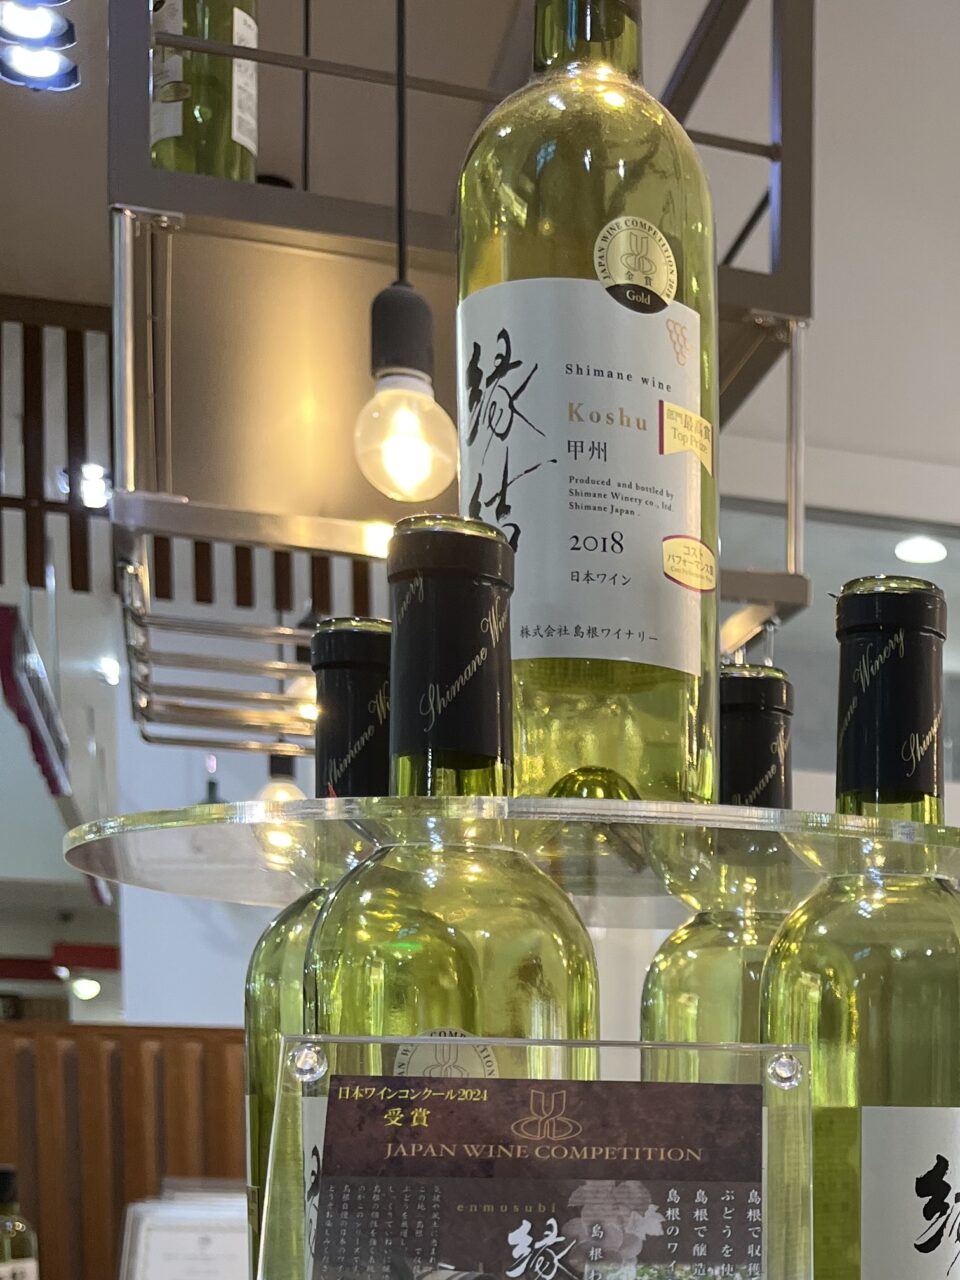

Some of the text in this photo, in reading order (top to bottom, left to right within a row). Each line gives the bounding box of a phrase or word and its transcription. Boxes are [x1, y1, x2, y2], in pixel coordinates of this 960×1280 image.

[626, 289, 651, 305] Gold
[565, 363, 672, 392] Shimane wine
[567, 401, 648, 432] Koshu
[567, 439, 608, 463] 甲州
[671, 426, 708, 455] Top Prize
[568, 475, 675, 500] Produced and bottled by
[568, 488, 608, 499] Shimane
[611, 491, 643, 506] Winery
[568, 501, 608, 513] Shimane
[569, 530, 624, 554] 2018
[570, 570, 632, 587] 日本ワイン
[519, 624, 659, 642] 株式会社島根ワイナリー
[852, 627, 905, 693] Winery
[419, 646, 488, 733] Shimane
[337, 1085, 489, 1102] 日本ワインコンクール2024
[383, 1107, 431, 1128] 受賞
[384, 1143, 703, 1162] JAPAN WINE COMPETITION
